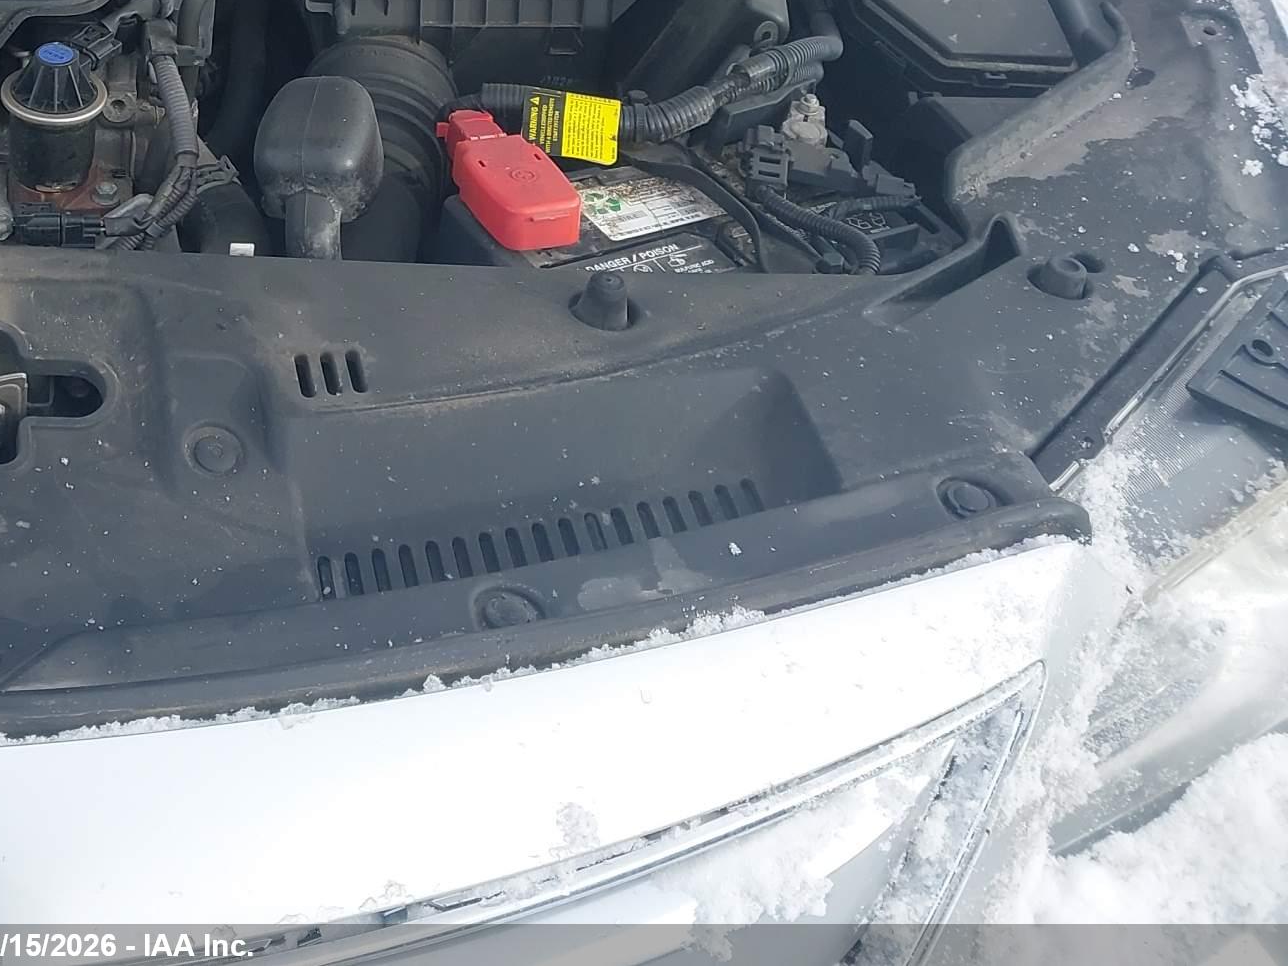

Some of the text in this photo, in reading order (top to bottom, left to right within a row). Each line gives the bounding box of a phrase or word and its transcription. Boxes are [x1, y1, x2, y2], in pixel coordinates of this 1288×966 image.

[529, 107, 538, 141] WARNING
[585, 256, 631, 272] DANGER
[638, 244, 679, 259] POISON
